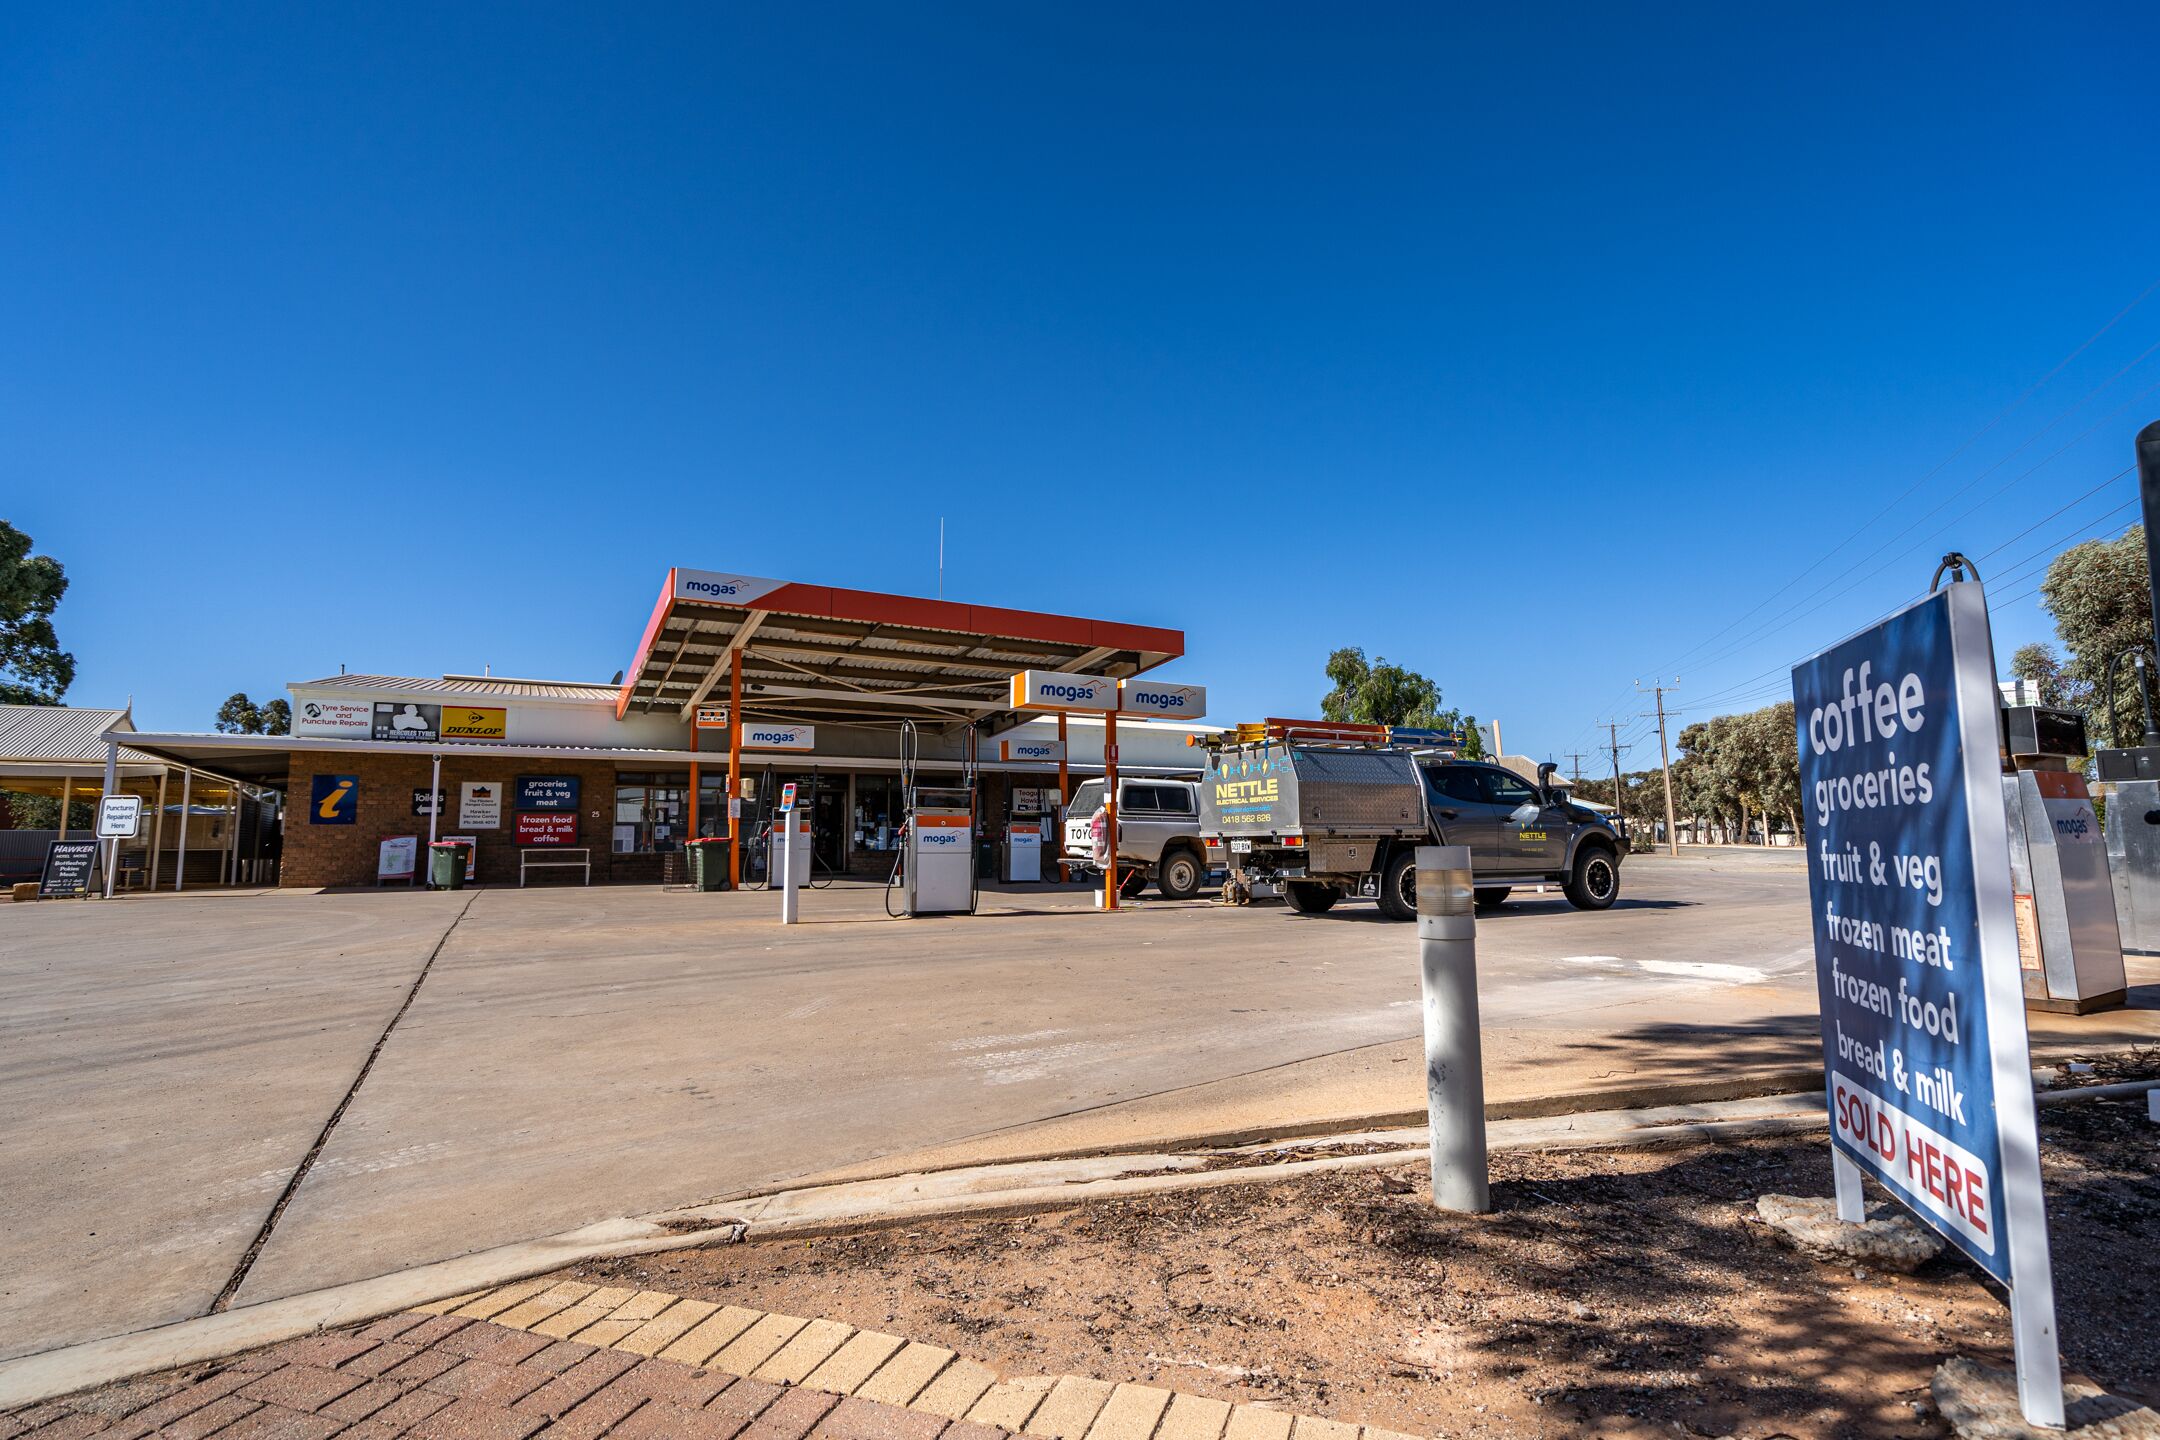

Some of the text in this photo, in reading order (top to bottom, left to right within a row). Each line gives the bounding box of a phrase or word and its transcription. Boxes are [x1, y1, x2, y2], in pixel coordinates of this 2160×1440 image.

[686, 582, 736, 596] mogas
[1040, 684, 1093, 701] mogas
[1136, 693, 1184, 708] mogas
[340, 705, 369, 713] Service
[1810, 660, 1925, 755] coffee
[446, 726, 502, 735] DUNLOP
[752, 732, 794, 744] mogas
[1018, 747, 1050, 756] mogas
[1216, 779, 1278, 798] NETTLE
[1815, 752, 1933, 826] groceries
[2057, 819, 2088, 839] mogas
[924, 836, 956, 844] mogas
[1821, 839, 1942, 906] fruit & veg
[1826, 900, 1954, 971] frozen meat
[1832, 957, 1959, 1045] frozen food
[1836, 1019, 1967, 1126] bread & milk
[1837, 1085, 1988, 1235] SOLD HERE
